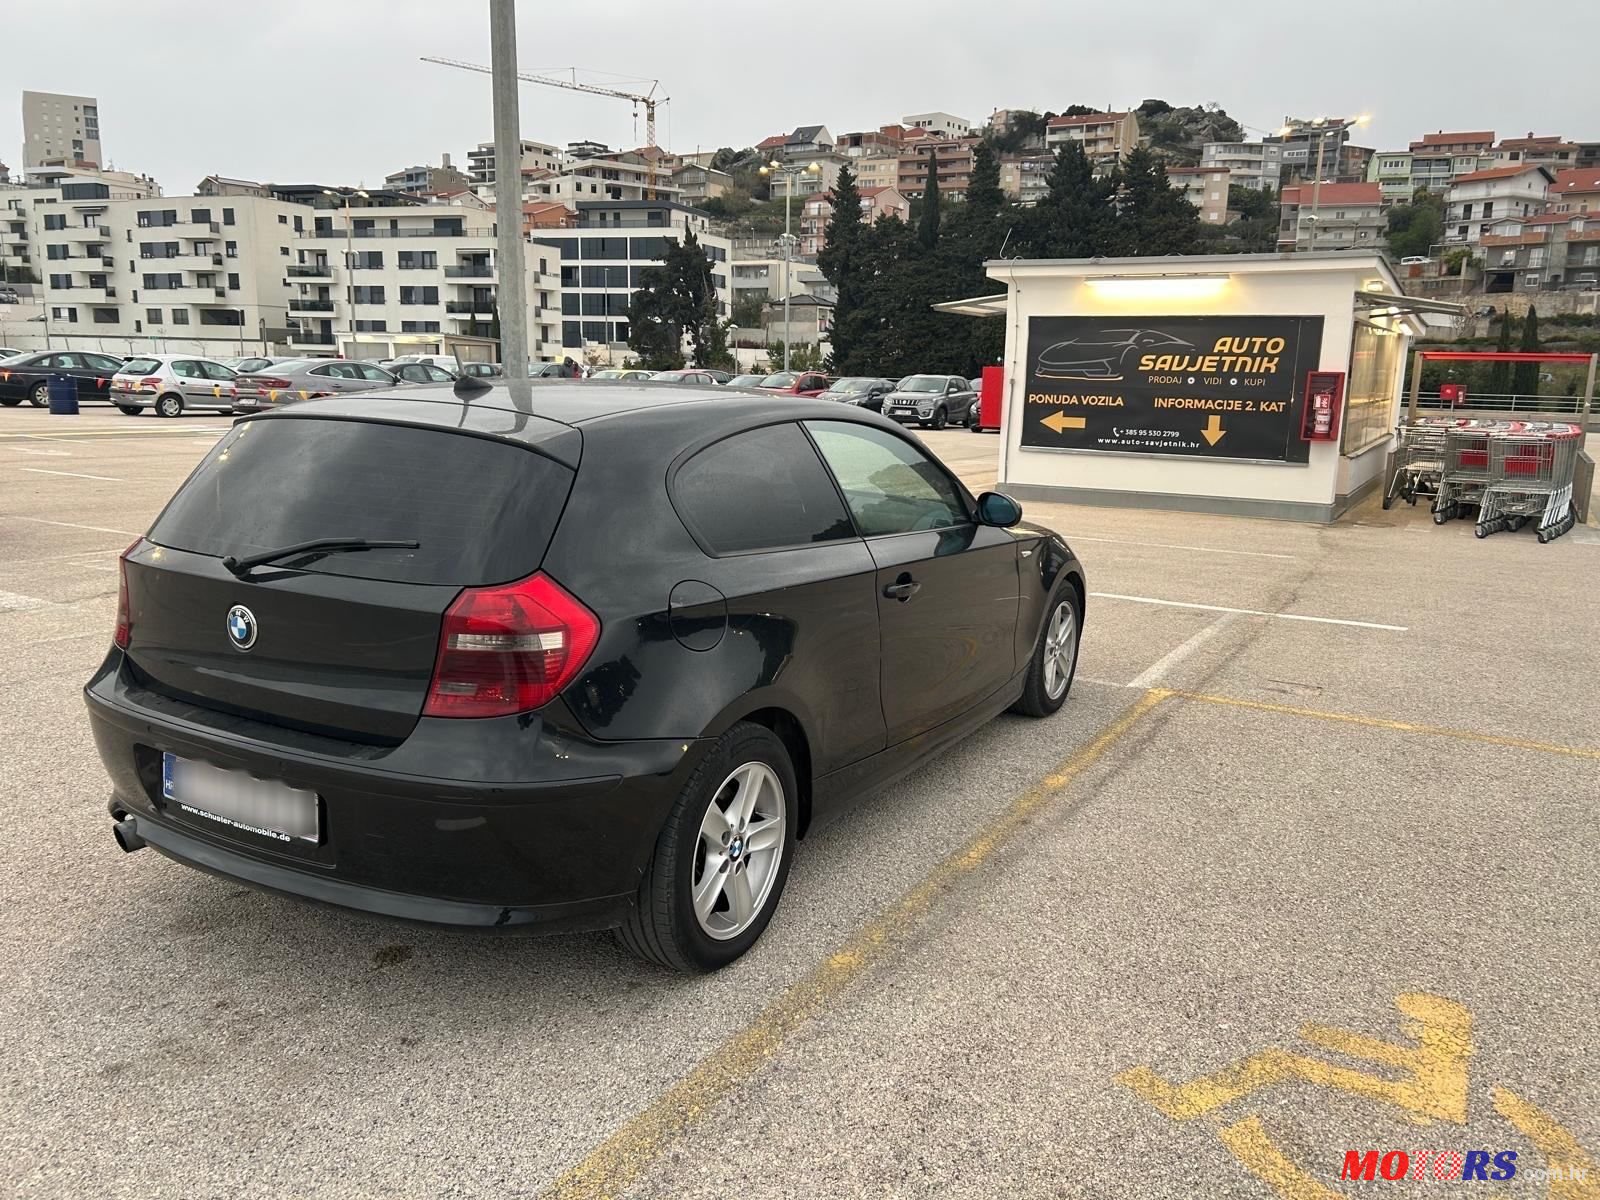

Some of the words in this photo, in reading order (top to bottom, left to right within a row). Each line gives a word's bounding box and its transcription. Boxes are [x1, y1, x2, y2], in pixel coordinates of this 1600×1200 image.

[1213, 336, 1285, 354] AUTO
[1138, 354, 1279, 373] SAVJETNIK
[1148, 375, 1183, 385] PRODAJ
[1203, 377, 1223, 385] VIDI
[1244, 378, 1266, 387] KUPI
[1028, 393, 1079, 406] PONUDA
[1081, 395, 1124, 407] VOZILA
[1153, 397, 1242, 411] INFORMACIJE
[1245, 400, 1257, 411] 2.
[1260, 400, 1286, 413] KAT
[1162, 430, 1180, 438] 2799
[1097, 438, 1200, 448] www.auto-savjetnik.hr
[181, 803, 291, 842] www.schuster-automobile.de
